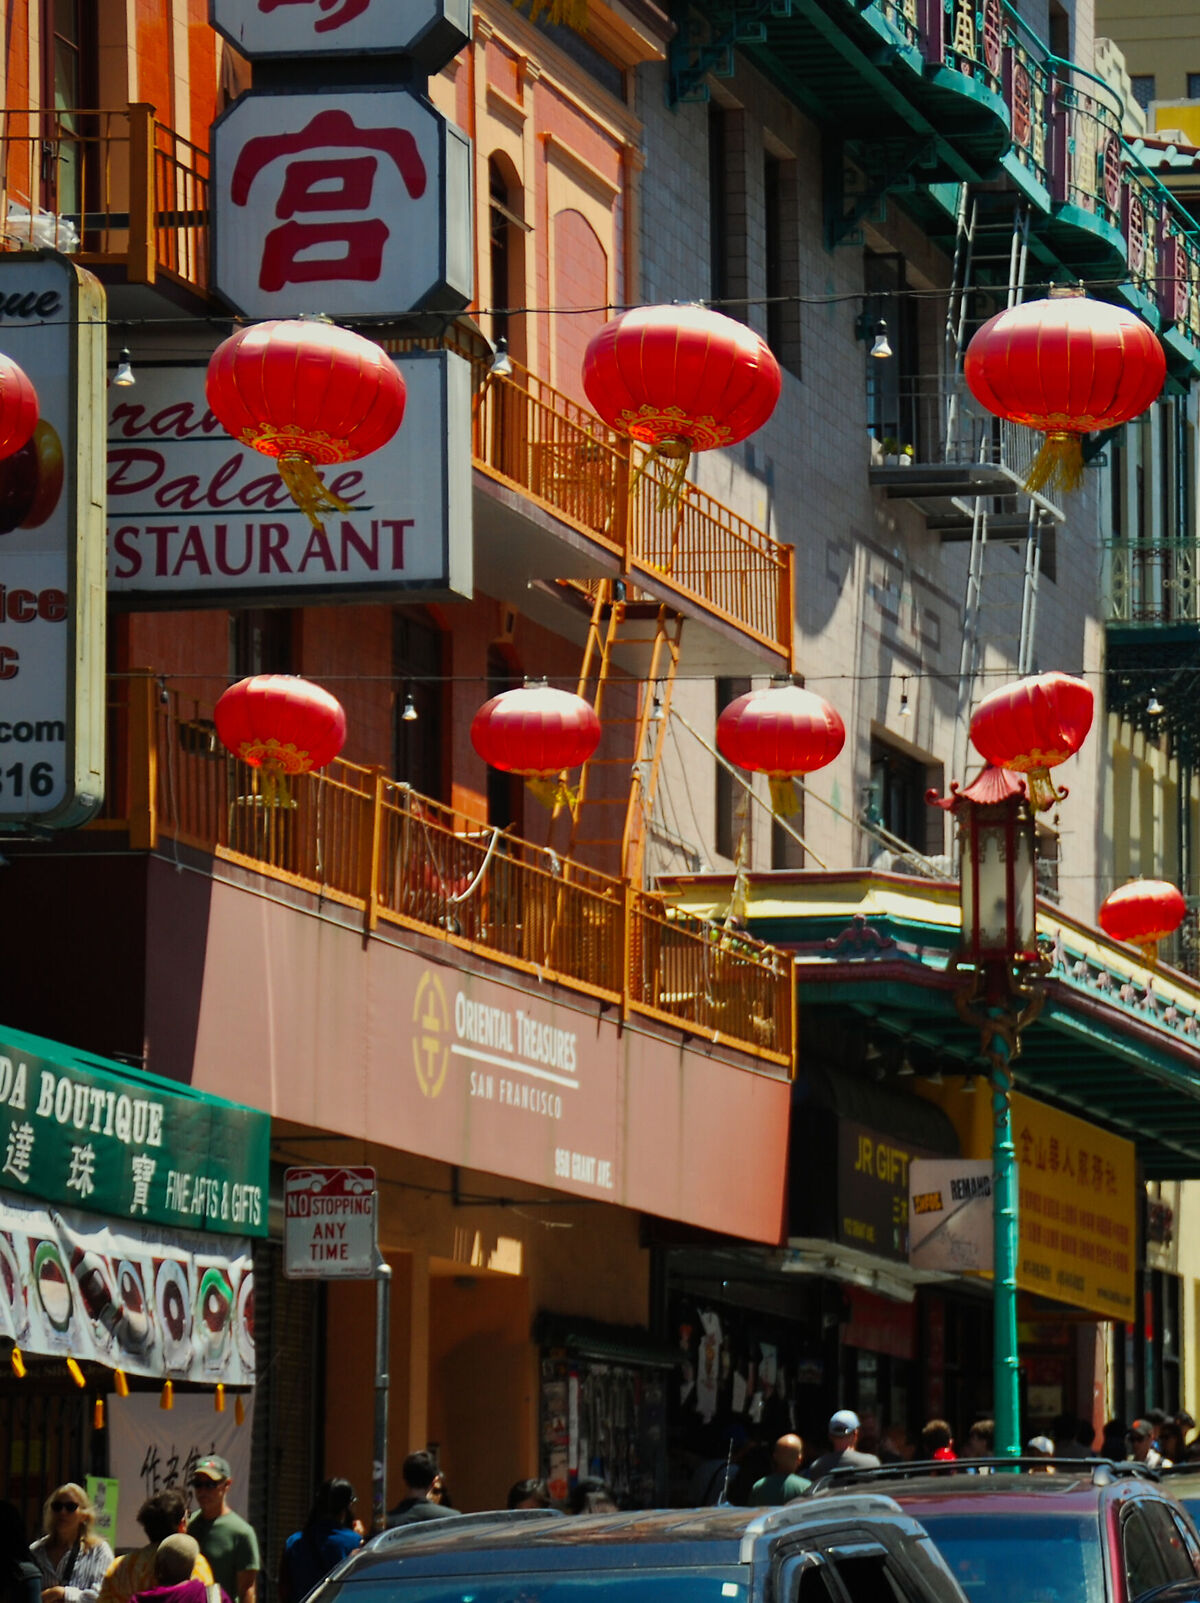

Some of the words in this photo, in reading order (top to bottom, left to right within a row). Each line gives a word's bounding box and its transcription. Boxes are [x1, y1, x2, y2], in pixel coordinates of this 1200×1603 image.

[106, 519, 415, 579] STAURANT
[0, 762, 54, 797] 16
[35, 1070, 164, 1147] BOUTIQUE
[470, 1071, 493, 1100] SAN
[499, 1079, 562, 1119] FRANCISCO
[855, 1136, 873, 1175] JR
[165, 1170, 191, 1214] FINE
[221, 1181, 229, 1220] &
[232, 1183, 262, 1226] GIFTS
[288, 1194, 309, 1216] NO
[312, 1198, 371, 1215] STOPPING
[313, 1223, 346, 1239] ANY
[310, 1243, 349, 1261] TIME
